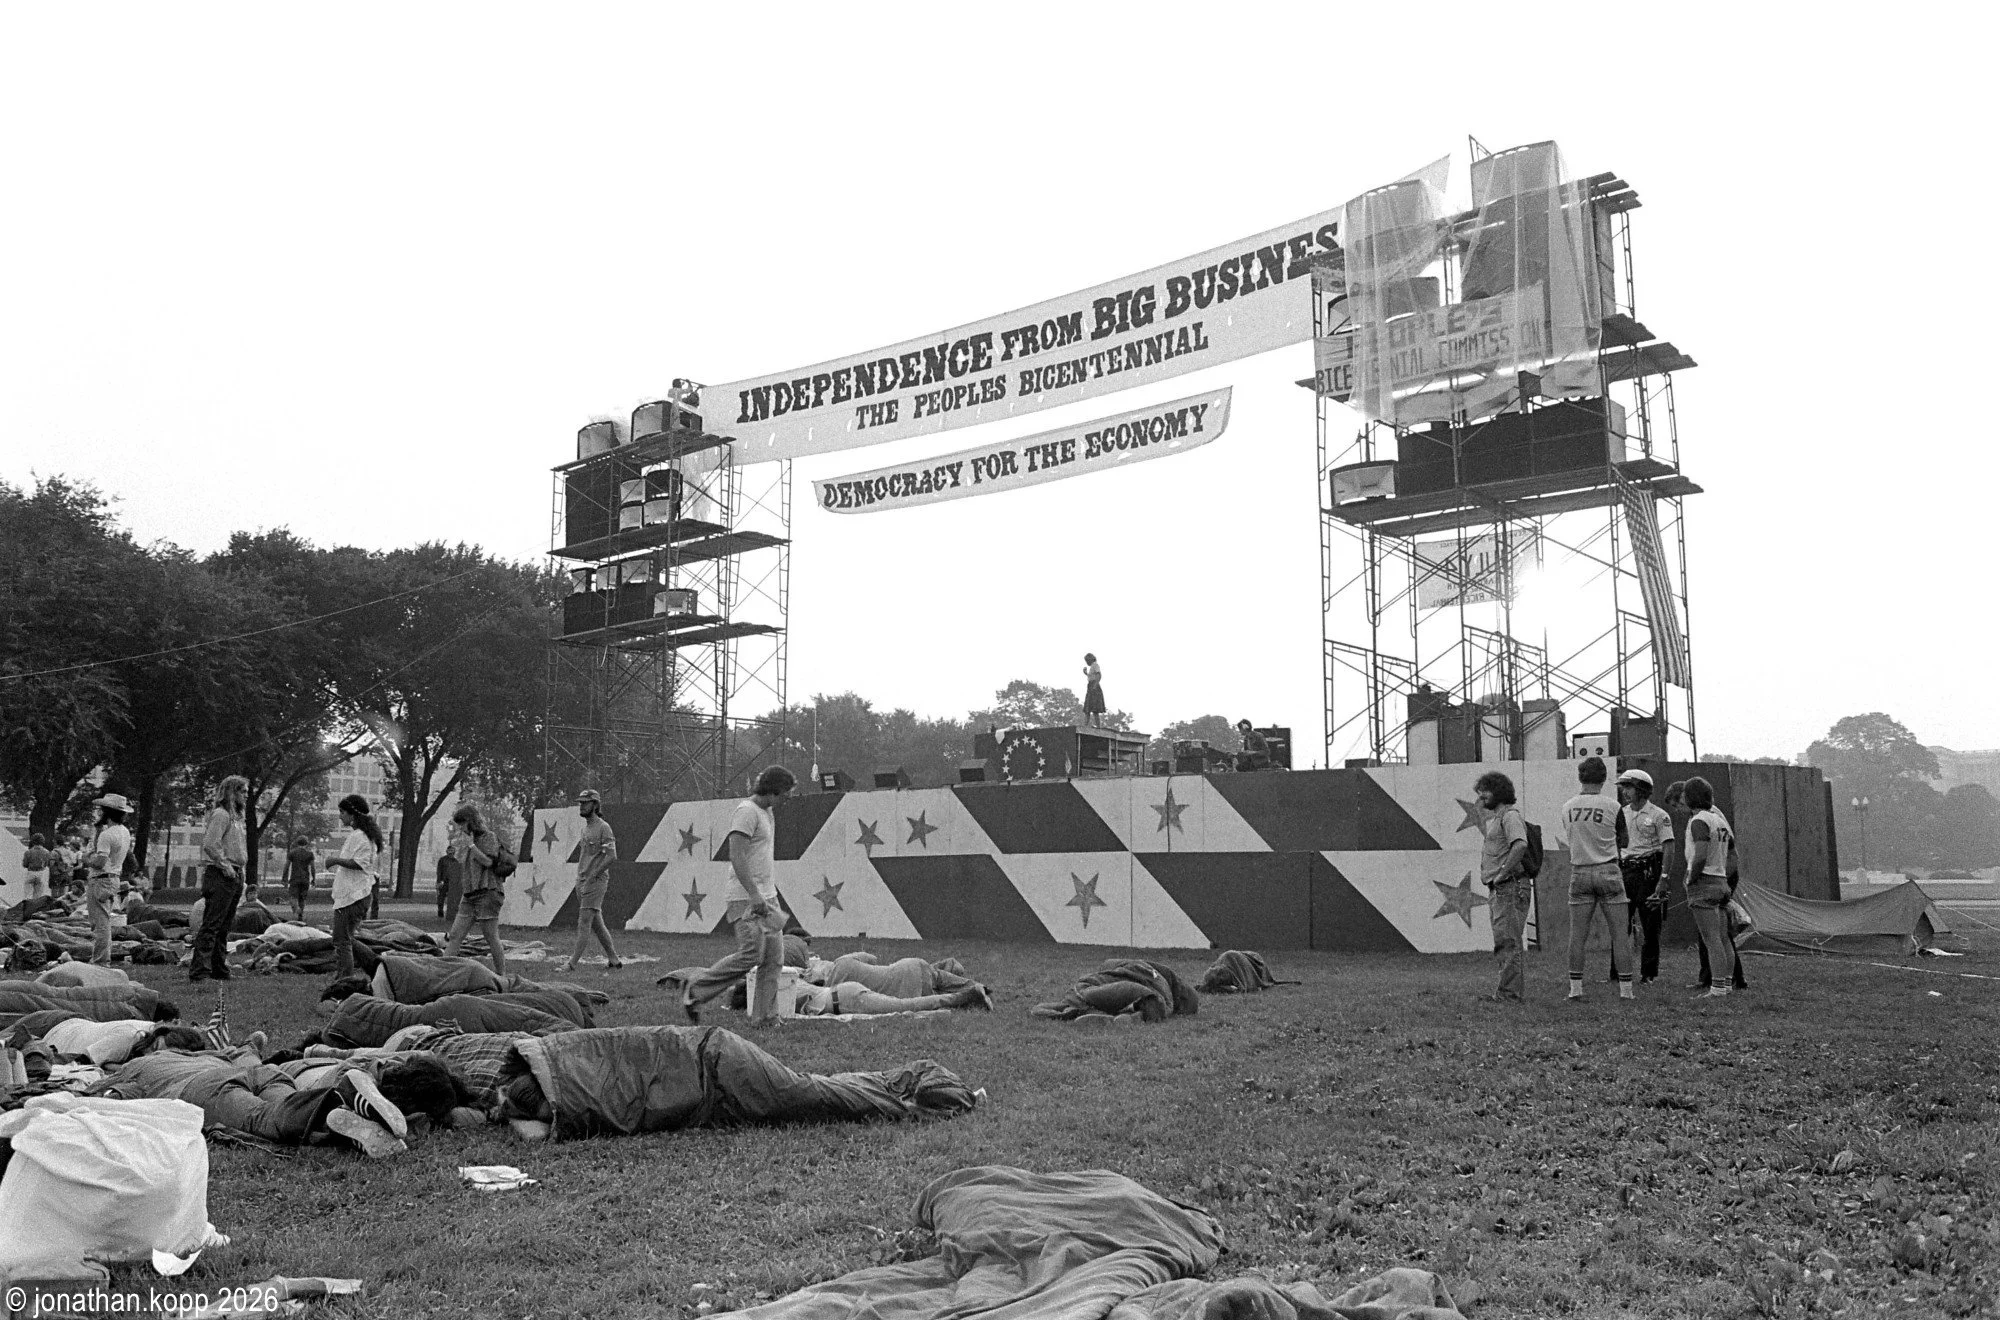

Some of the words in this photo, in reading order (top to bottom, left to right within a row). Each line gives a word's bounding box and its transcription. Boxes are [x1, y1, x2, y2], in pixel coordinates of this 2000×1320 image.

[736, 332, 993, 424] INDEPENDENCE
[1001, 311, 1083, 361] FROM
[1091, 285, 1156, 341] BIG
[1165, 222, 1339, 320] BUSINES
[1439, 317, 1542, 369] COMMISSON
[856, 400, 899, 430] THE
[913, 374, 1007, 419] PEOPLES
[1018, 321, 1209, 396] BICENTENNIAL
[823, 461, 964, 508] DEMOCRACY
[971, 450, 1019, 484] FOR
[1024, 438, 1076, 472] THE
[1085, 403, 1209, 459] ECONOMY
[1568, 807, 1602, 824] 1776
[1716, 827, 1729, 842] 17
